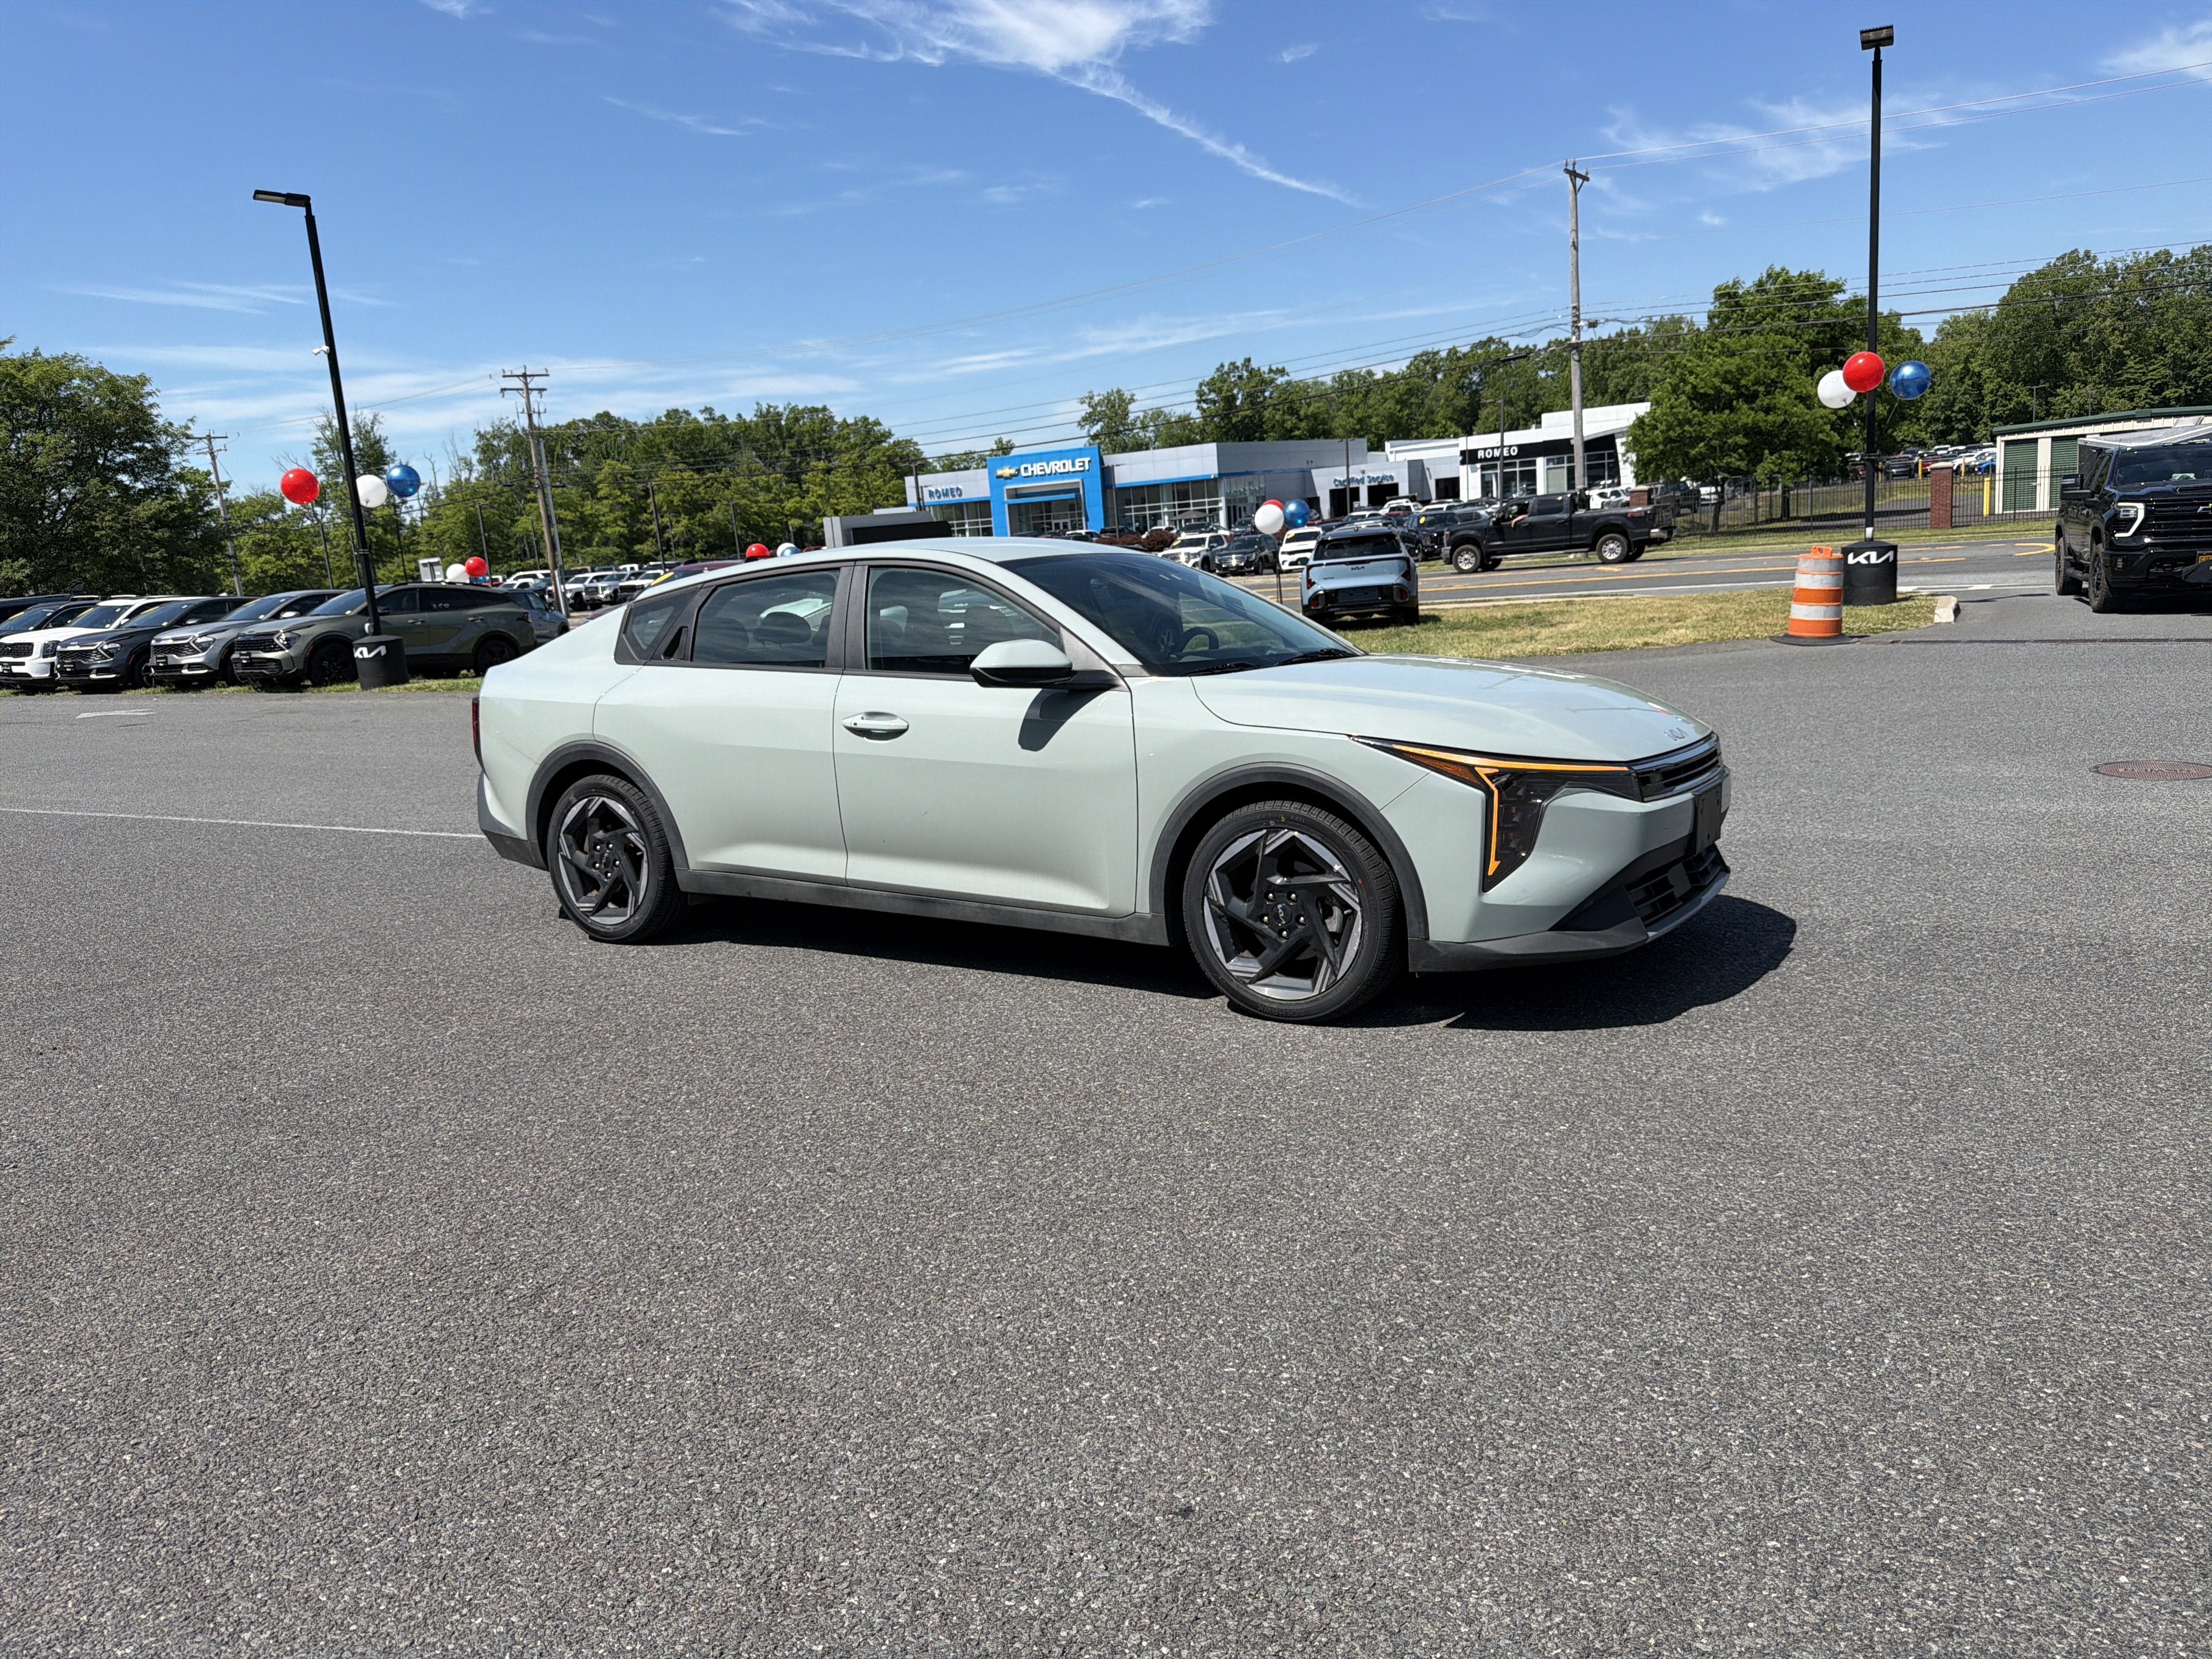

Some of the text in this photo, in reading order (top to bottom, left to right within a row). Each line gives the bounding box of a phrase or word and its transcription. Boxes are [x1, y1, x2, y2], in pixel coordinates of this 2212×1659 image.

[1477, 446, 1518, 459] ROMEO
[1020, 457, 1090, 477] CHEVROLET
[928, 487, 963, 500] ROMEO
[1848, 550, 1894, 564] KIA
